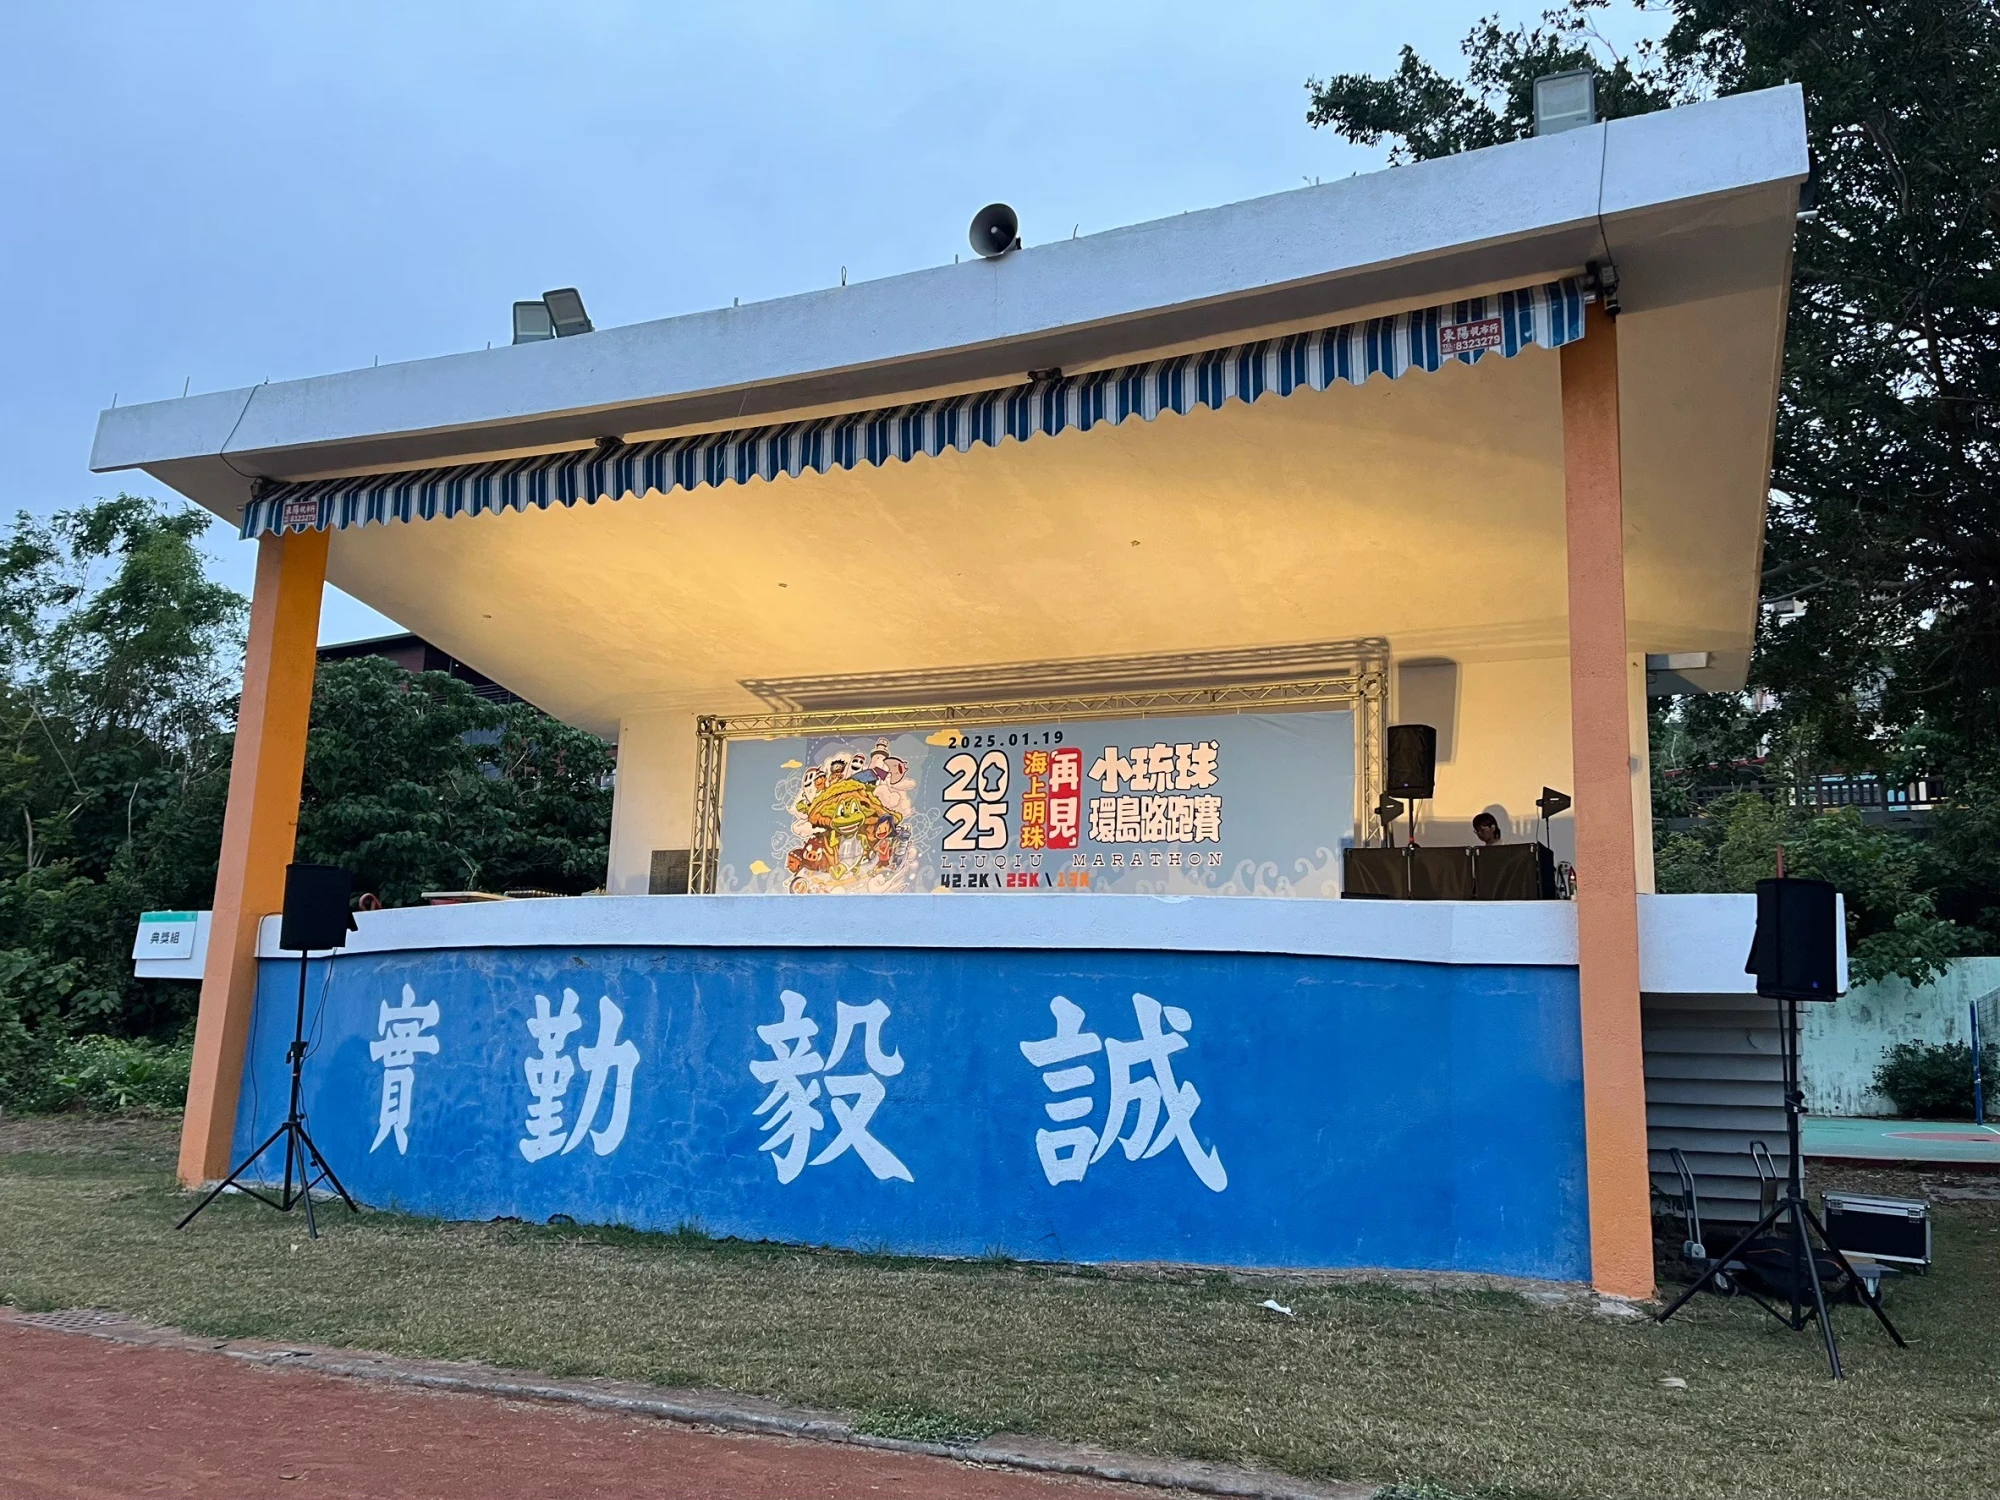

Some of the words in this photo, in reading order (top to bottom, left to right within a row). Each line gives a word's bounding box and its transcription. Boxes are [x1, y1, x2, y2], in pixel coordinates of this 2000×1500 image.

[1456, 336, 1500, 350] 8323279
[948, 731, 1064, 749] 2025.01.19
[942, 750, 1010, 802] 20
[1087, 739, 1220, 793] 小琉球
[1020, 750, 1049, 850] 海上明珠
[1088, 794, 1222, 844] 環島路跑賽
[942, 801, 1009, 851] 25
[941, 854, 1043, 869] LIUQIU
[1073, 852, 1223, 866] MARATHON
[941, 873, 989, 888] 42.2K
[1006, 872, 1040, 887] 25K
[1057, 872, 1091, 887] 13K
